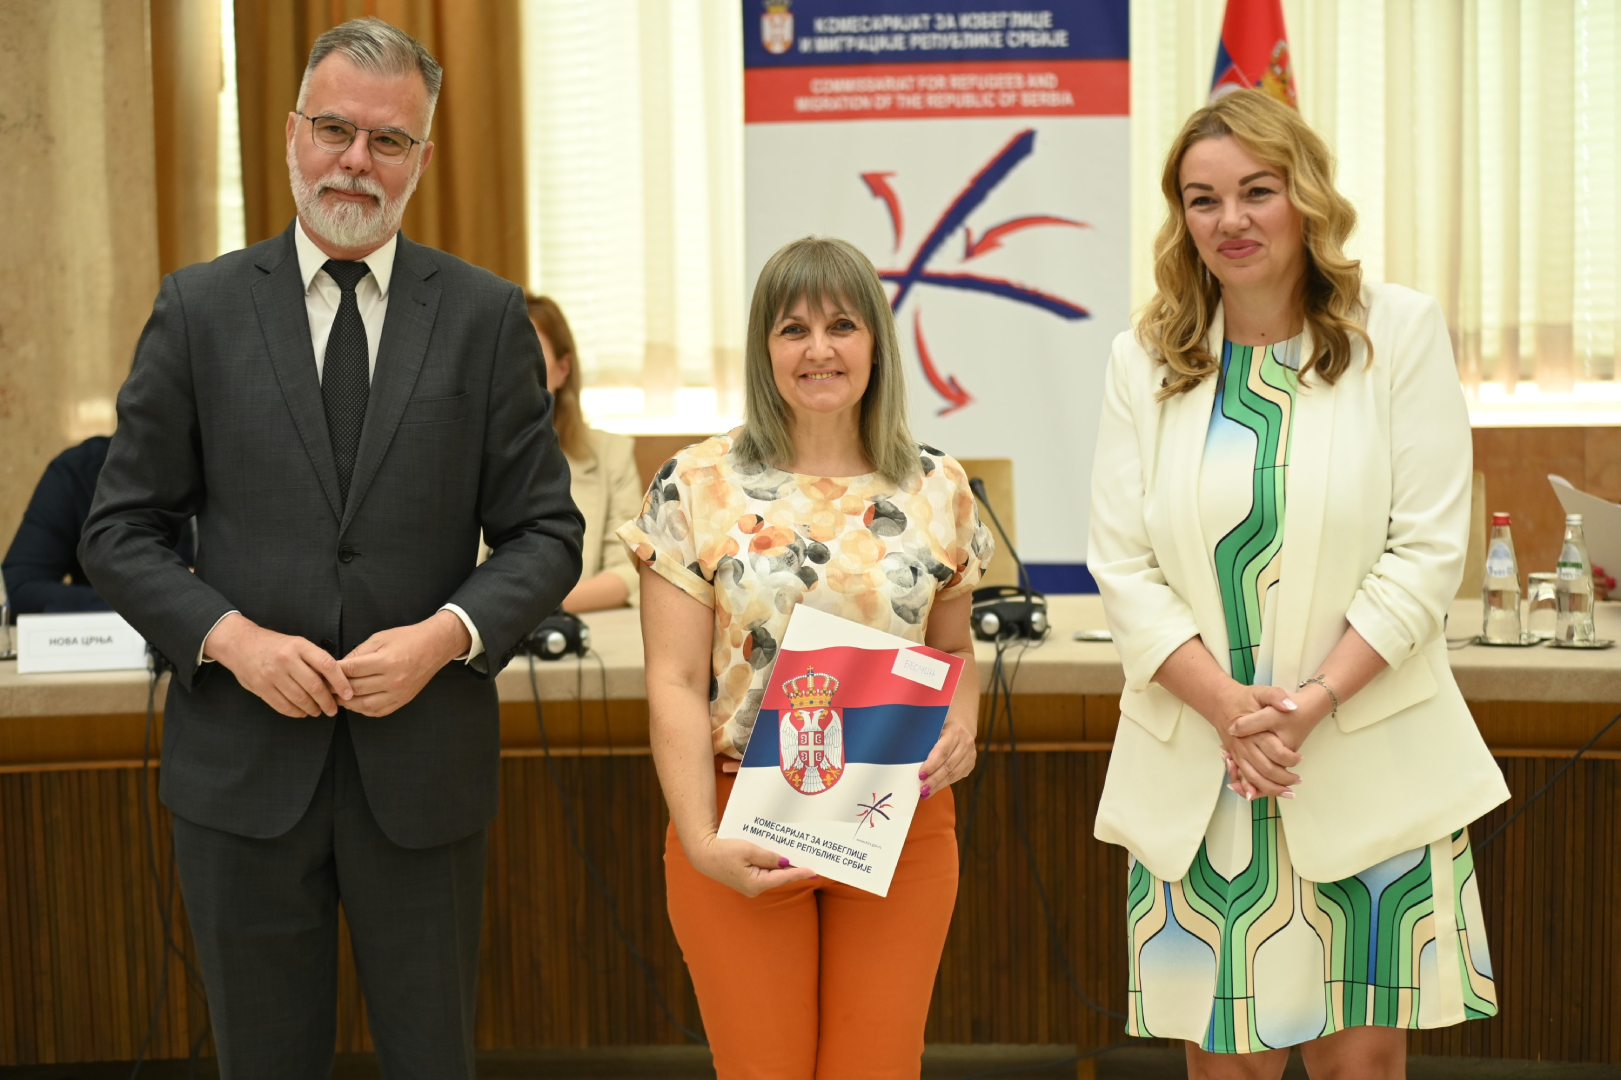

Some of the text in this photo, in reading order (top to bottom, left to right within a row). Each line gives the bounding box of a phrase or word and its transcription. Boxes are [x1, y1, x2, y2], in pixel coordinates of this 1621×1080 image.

[814, 10, 1053, 33] КОМЕСАРИЈАТ ЗА ИЗБЕГЛИЦЕ
[799, 29, 1069, 55] И МИГРАЦИЈЕ РЕПУБЛИКЕ СРБИЈЕ
[809, 72, 1059, 95] COMMISSARIAT FOR REFUGEES AND
[794, 89, 1075, 113] MIGRATION OF THE REPUBLIC OF SERBIA
[49, 635, 113, 647] НОВА ЦРЊА
[742, 823, 872, 874] И МИГРАЦИЈЕ РЕПУБЛИКЕ СРБИЈЕ
[754, 816, 868, 861] КОМЕСАРИЈАТ ЗА ИЗБЕГЛИЦЕ
